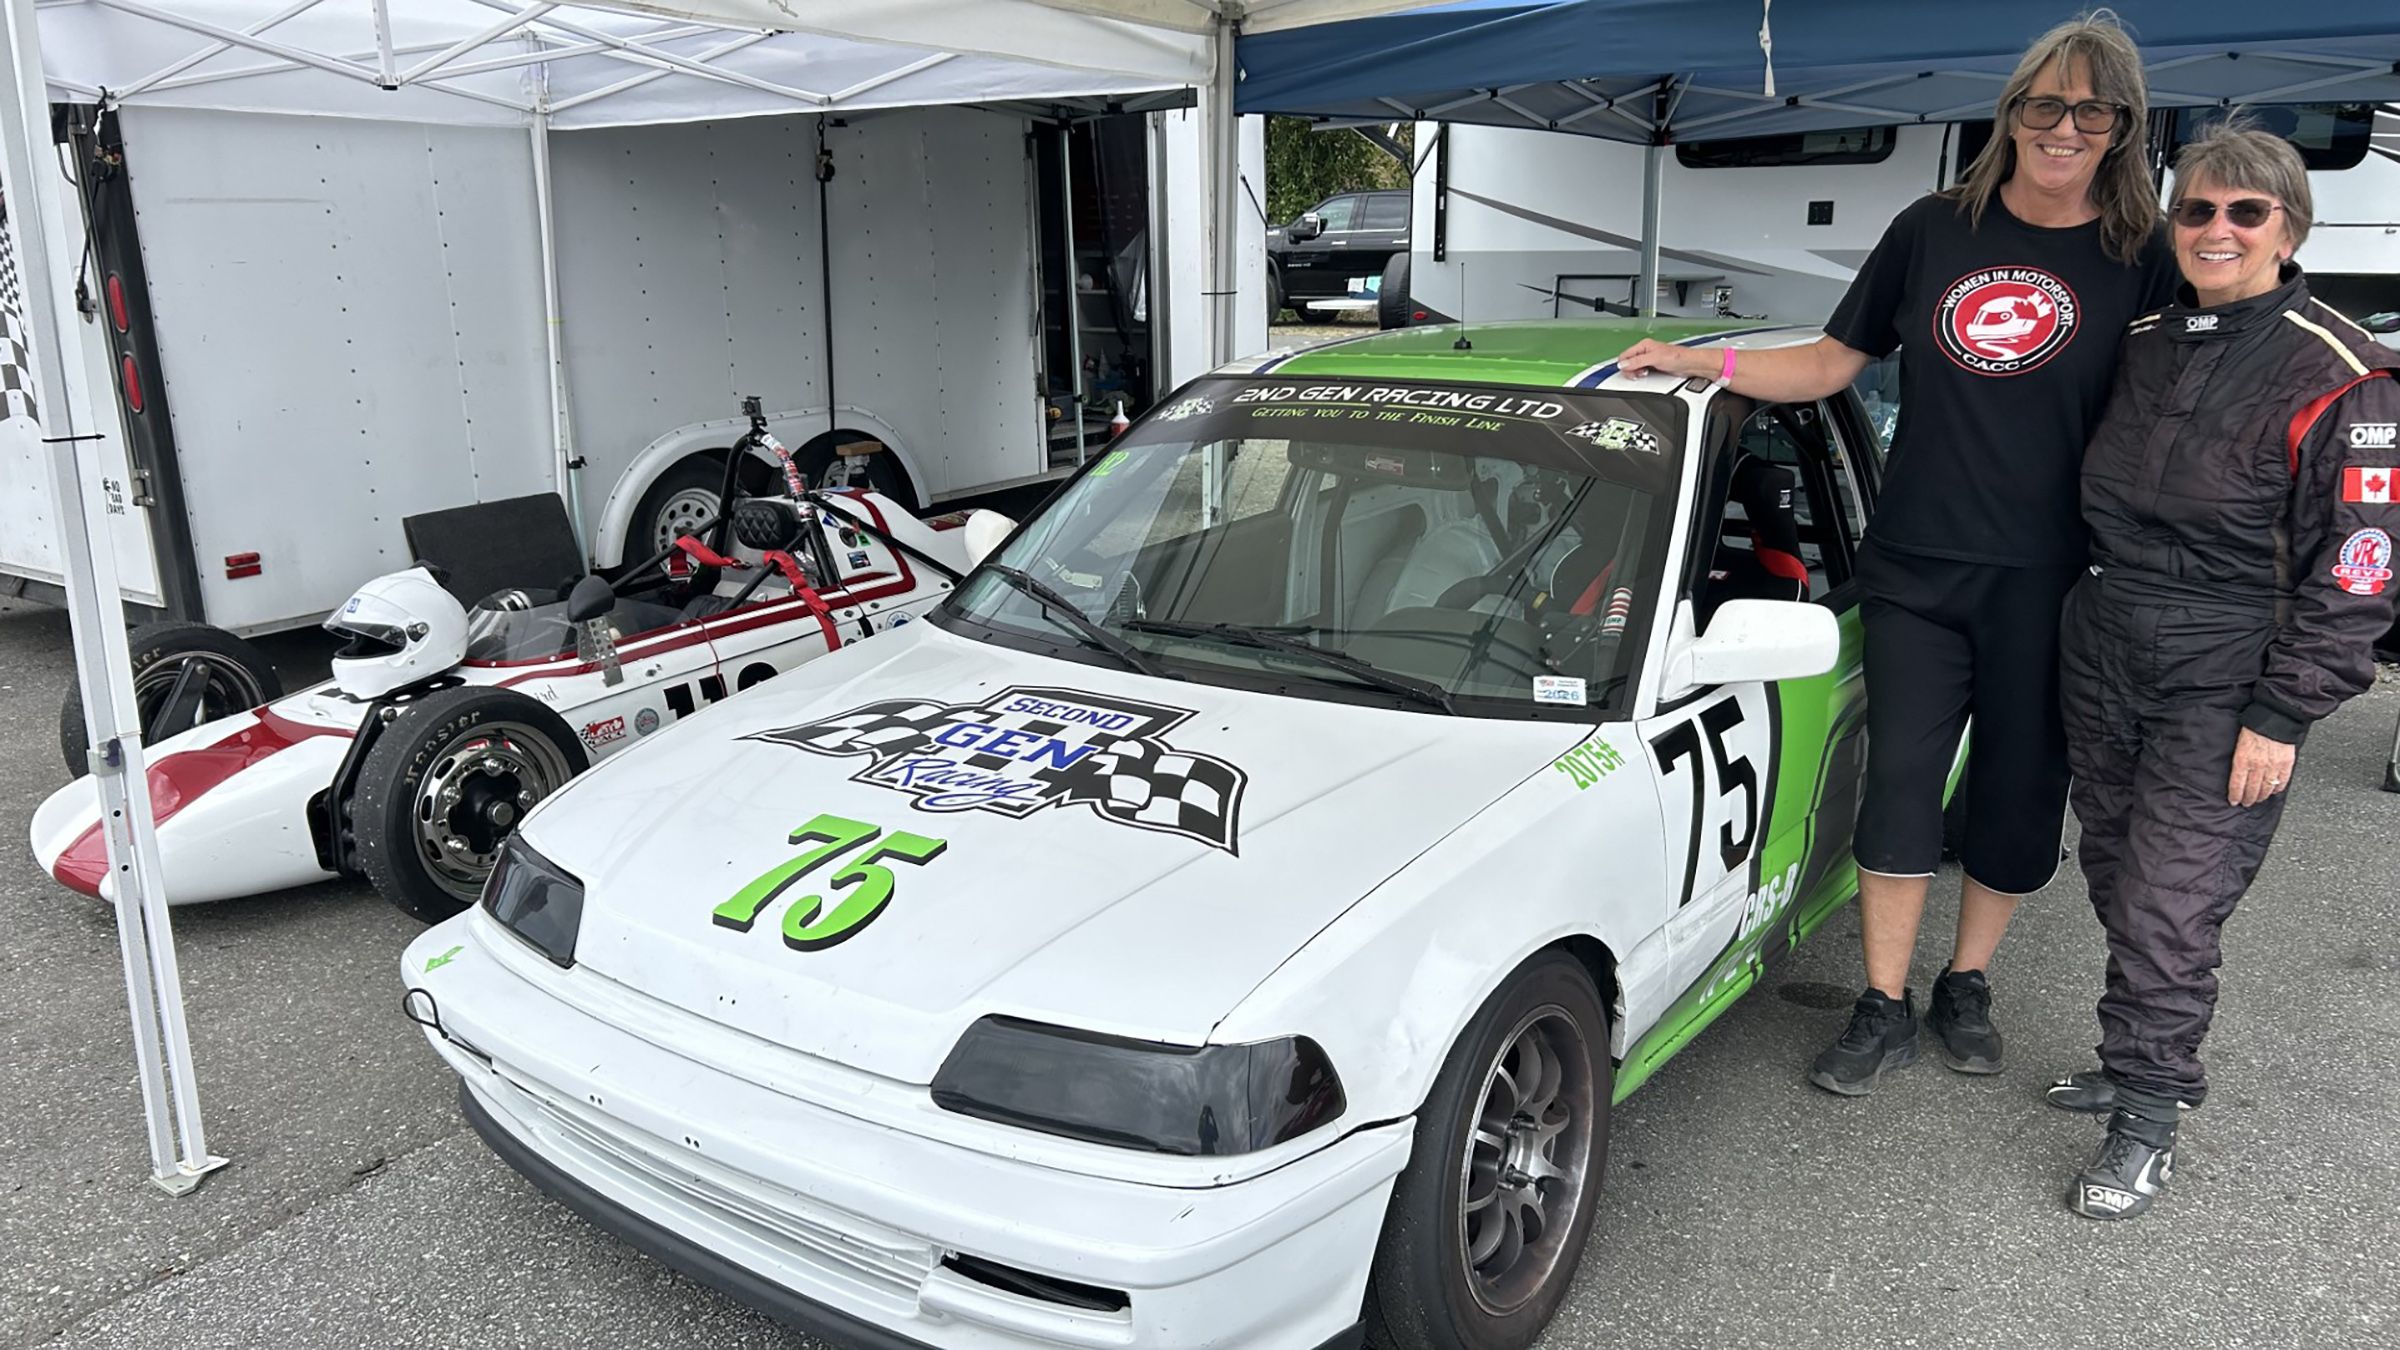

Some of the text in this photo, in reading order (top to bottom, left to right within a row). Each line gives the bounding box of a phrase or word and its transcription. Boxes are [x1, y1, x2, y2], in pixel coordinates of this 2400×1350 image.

[1943, 270, 2075, 327] WOMEN IN MOTORSPORT
[2186, 316, 2218, 329] OMP
[1962, 353, 2020, 372] CACC
[1233, 386, 1565, 419] 2ND GEN RACING LTD
[2350, 426, 2397, 446] OMP
[1004, 698, 1134, 731] SECOND
[934, 722, 1099, 770] GEN
[1554, 736, 1626, 791] 2075#
[880, 758, 1044, 806] Racing
[1648, 695, 1757, 909] 75
[713, 813, 947, 952] 75
[1738, 862, 1799, 941] CRS-B
[2086, 1187, 2136, 1211] OMP
